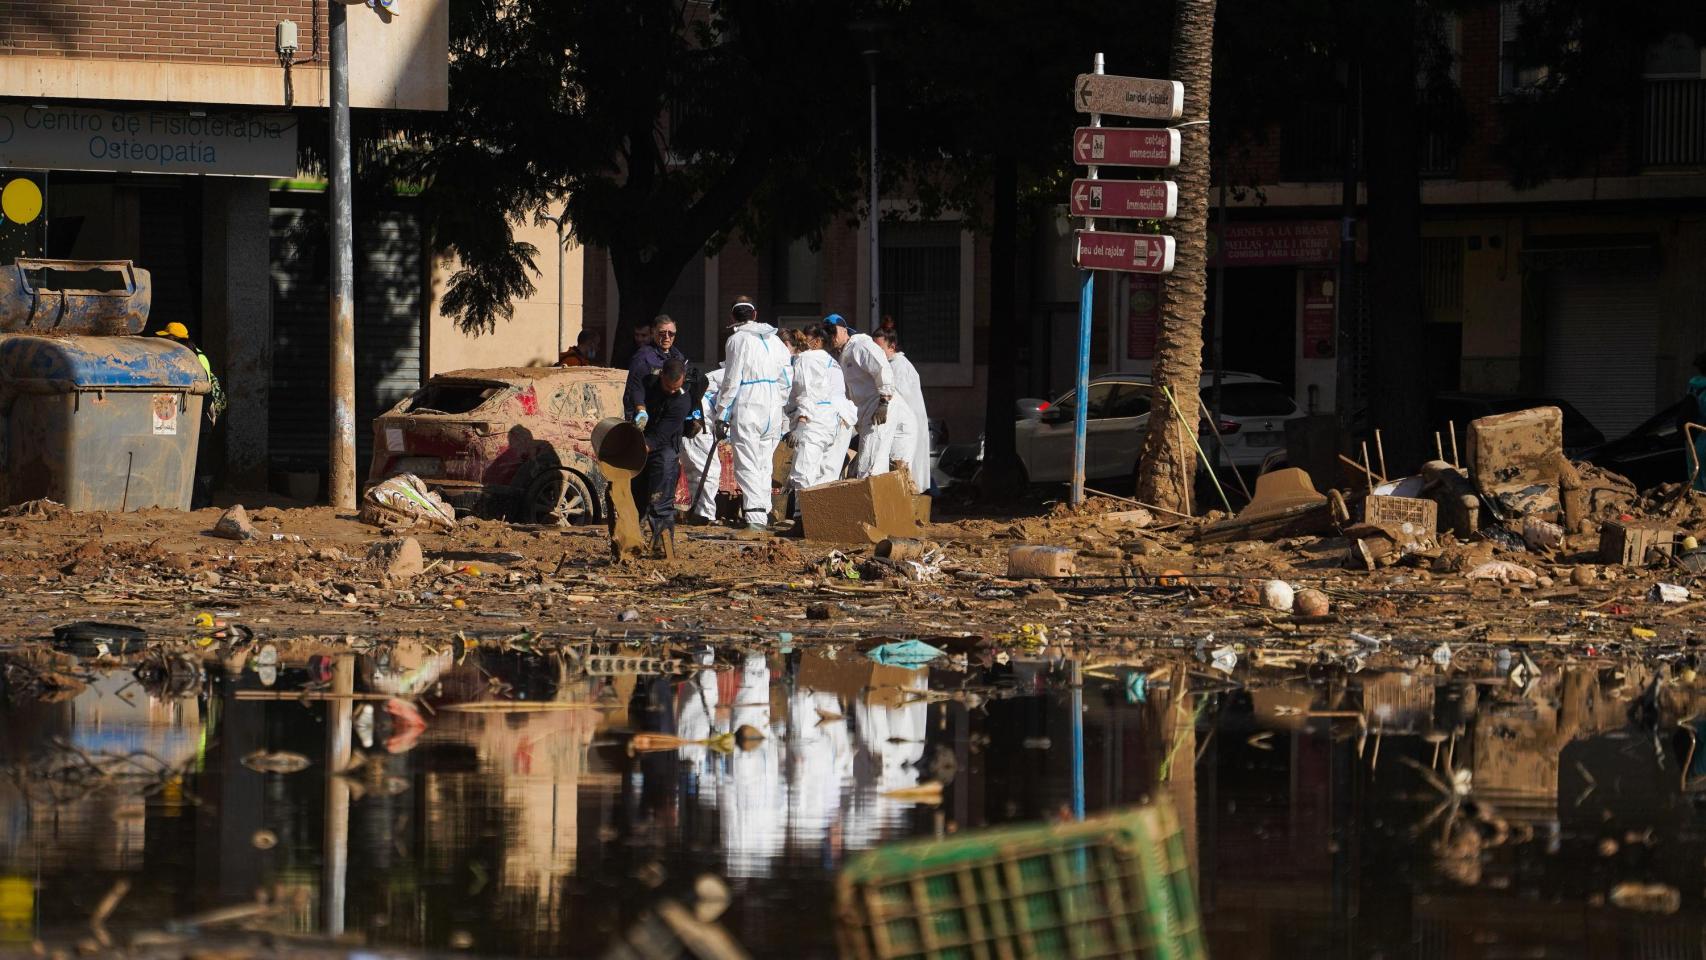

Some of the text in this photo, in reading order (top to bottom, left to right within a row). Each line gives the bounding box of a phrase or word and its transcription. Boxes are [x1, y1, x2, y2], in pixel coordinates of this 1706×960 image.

[1137, 92, 1147, 103] del
[24, 106, 103, 131] Centro
[112, 112, 140, 133] de
[89, 134, 217, 164] Osteopatía
[1266, 225, 1275, 236] A
[1295, 224, 1329, 235] BRASA
[1093, 244, 1104, 255] del
